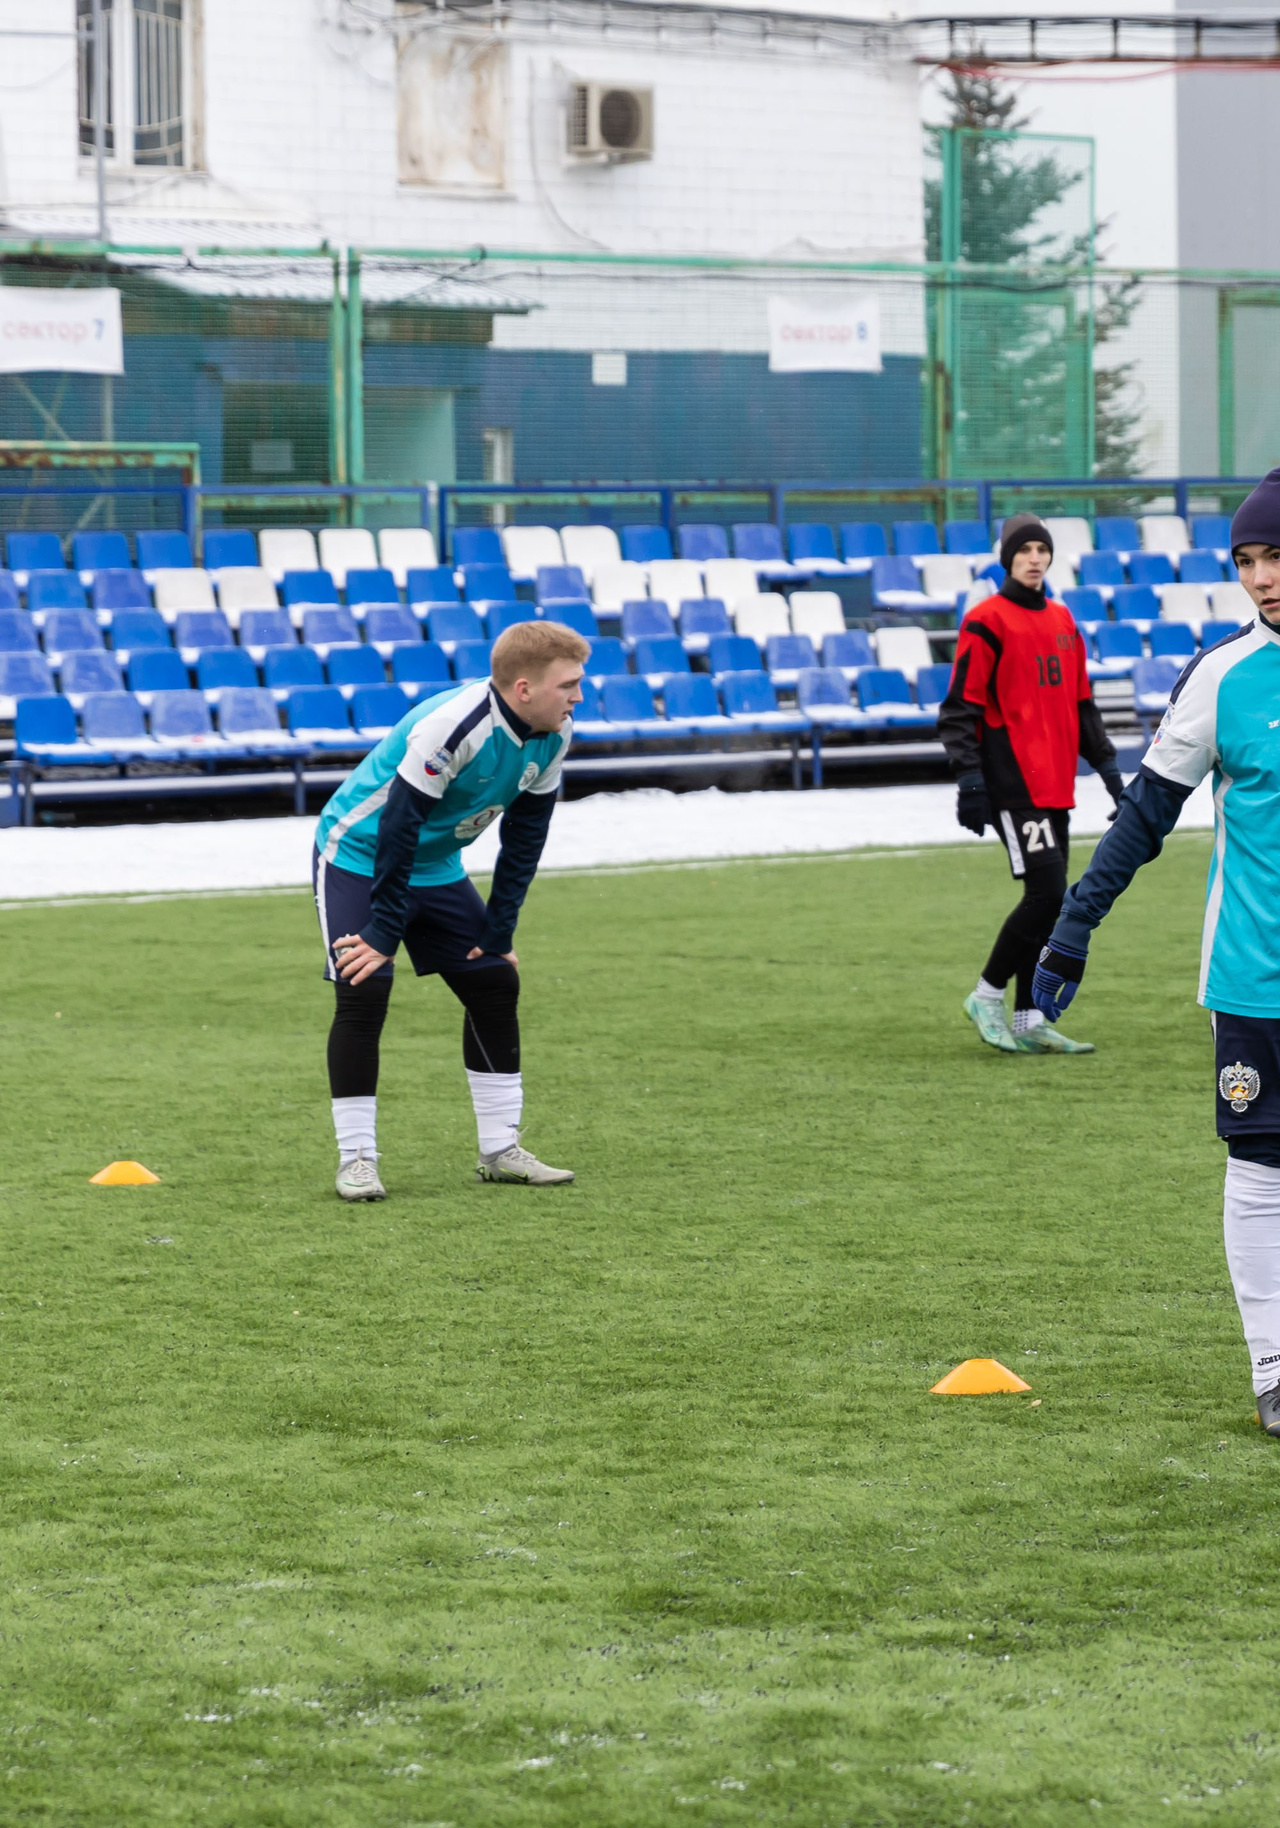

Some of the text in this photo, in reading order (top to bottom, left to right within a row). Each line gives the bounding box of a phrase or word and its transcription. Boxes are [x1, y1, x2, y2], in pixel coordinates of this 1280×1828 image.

[93, 317, 105, 341] 7
[1035, 654, 1062, 687] 18
[1022, 818, 1056, 853] 21
